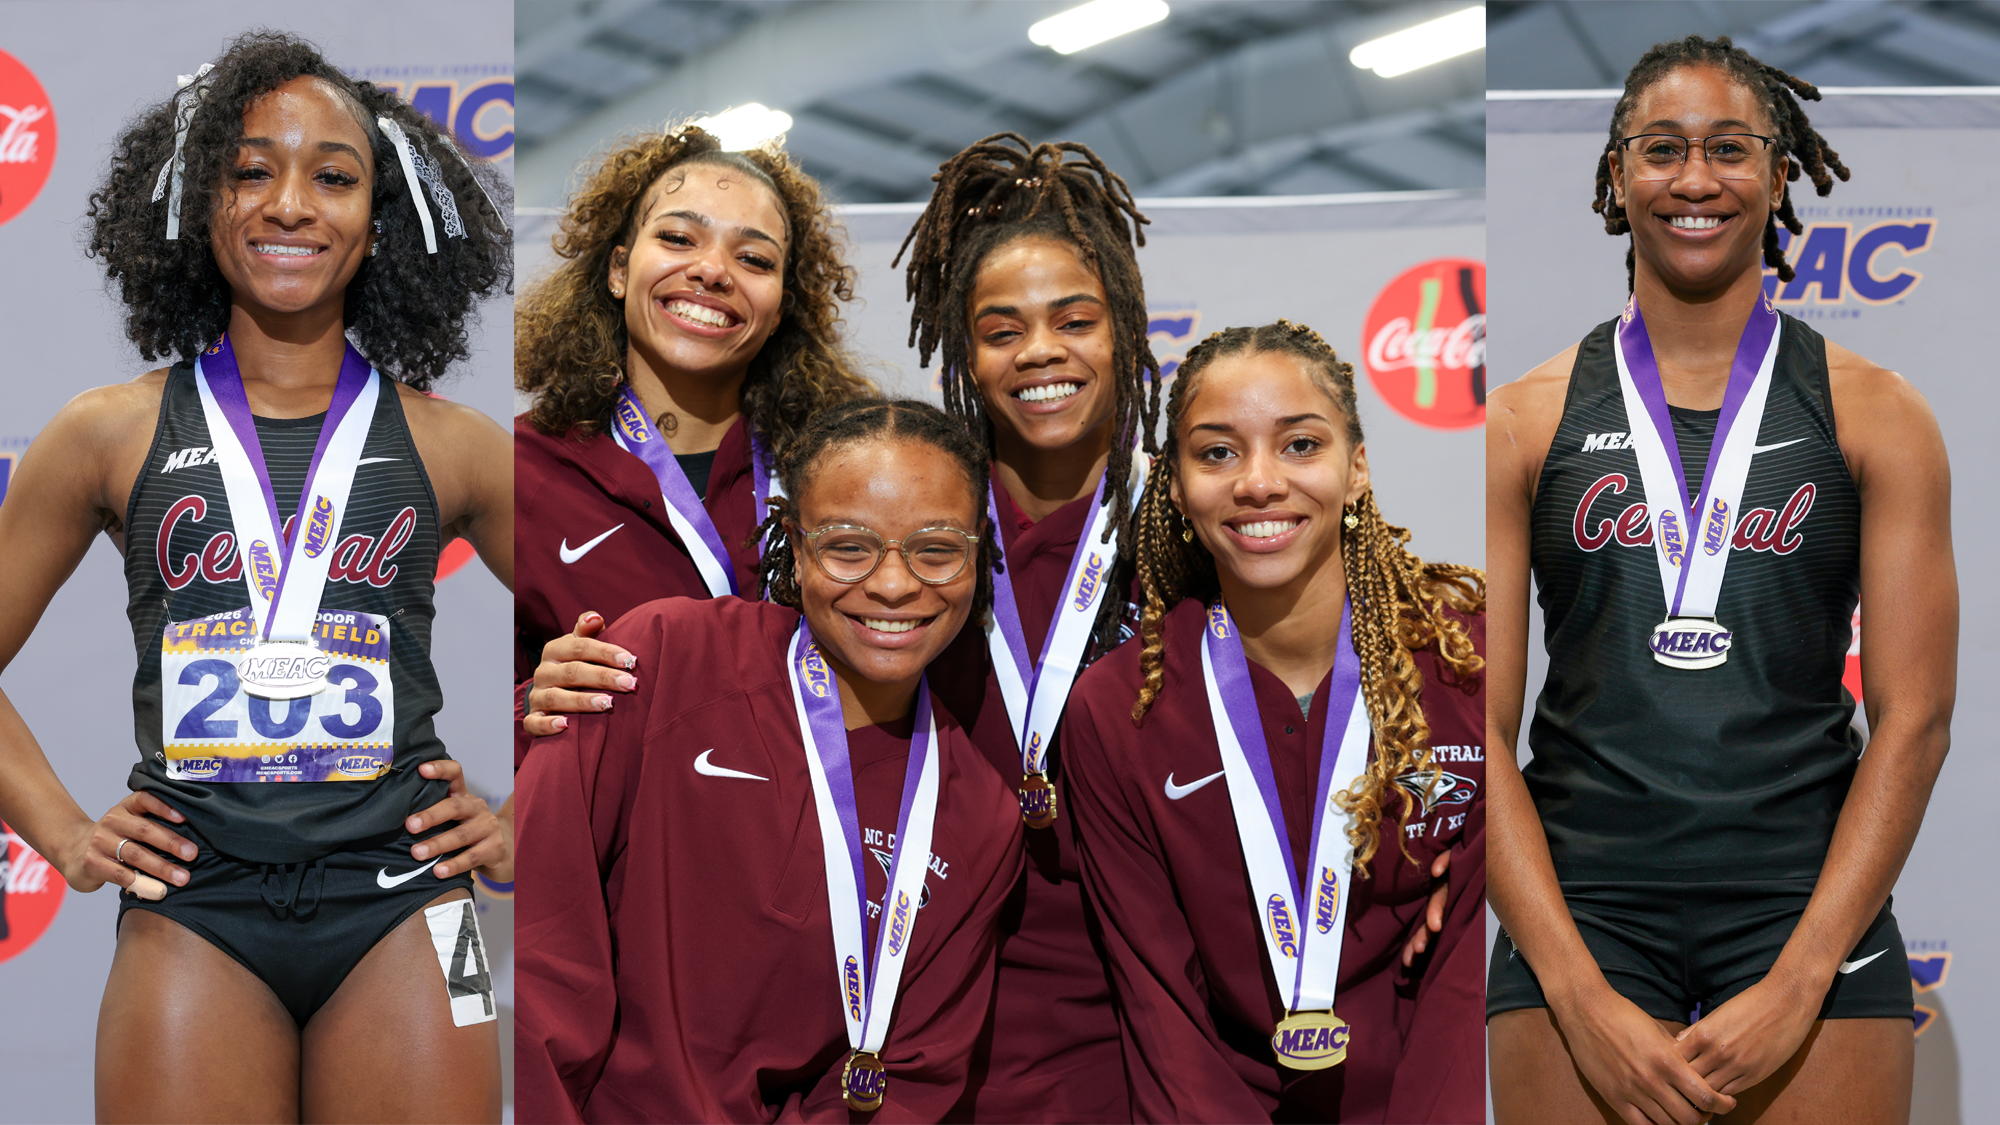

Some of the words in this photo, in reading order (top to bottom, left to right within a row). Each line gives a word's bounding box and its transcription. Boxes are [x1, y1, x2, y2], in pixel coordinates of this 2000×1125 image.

[1368, 313, 1486, 372] Coca-Co
[161, 447, 219, 474] MEA
[1581, 432, 1636, 453] MEA
[304, 495, 333, 556] MEAC
[1573, 473, 1816, 555] Ceal
[1660, 513, 1684, 567] MEAC
[1704, 497, 1728, 552] MEAC
[157, 495, 416, 591] Ceal
[251, 545, 278, 601] MEAC
[1075, 551, 1103, 608] MEAC
[204, 610, 242, 621] 2026
[1212, 601, 1231, 639] EAC
[1657, 631, 1733, 653] MEAC
[244, 656, 330, 681] MEAC
[174, 659, 383, 739] 203
[182, 759, 222, 772] MEAC
[340, 757, 382, 770] MEAC
[1027, 730, 1042, 773] EAC
[864, 827, 884, 847] NC
[1405, 822, 1427, 839] TF
[889, 889, 909, 950] MEAC
[1316, 866, 1338, 931] MEAC
[1269, 898, 1298, 959] MEAC
[447, 902, 492, 1016] 4
[845, 962, 861, 1023] MEAC
[1281, 1025, 1350, 1054] MEAC
